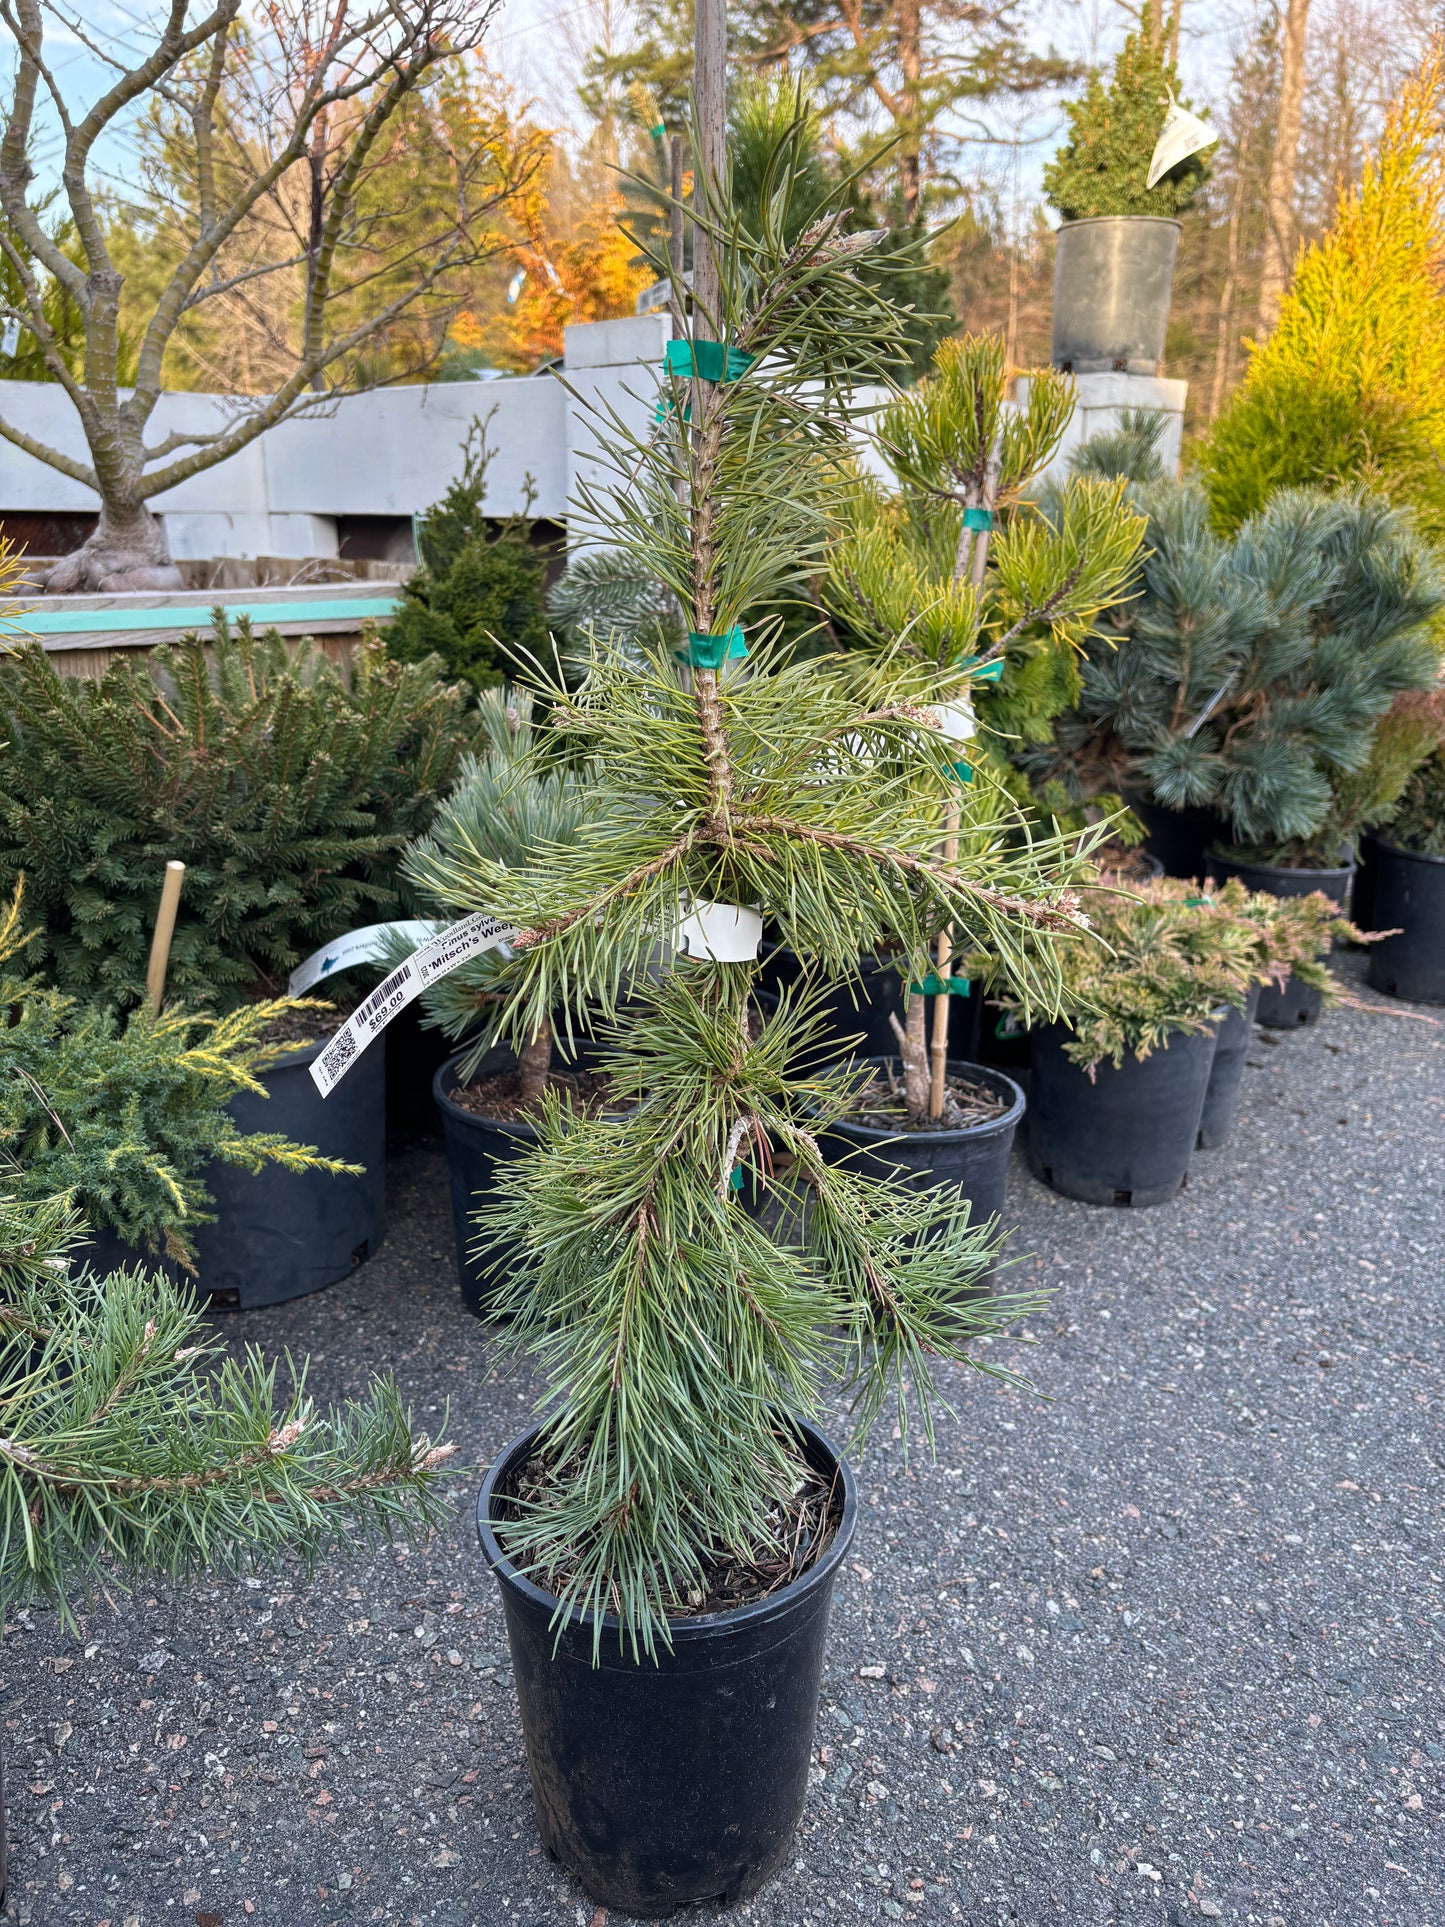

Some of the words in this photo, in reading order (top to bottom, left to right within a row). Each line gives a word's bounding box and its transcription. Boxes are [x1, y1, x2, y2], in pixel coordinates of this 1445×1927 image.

[431, 918, 471, 945] Woodland
[470, 916, 497, 933] sylve
[428, 936, 480, 970] 'Mitsch's
[368, 990, 404, 1030] $69.00
